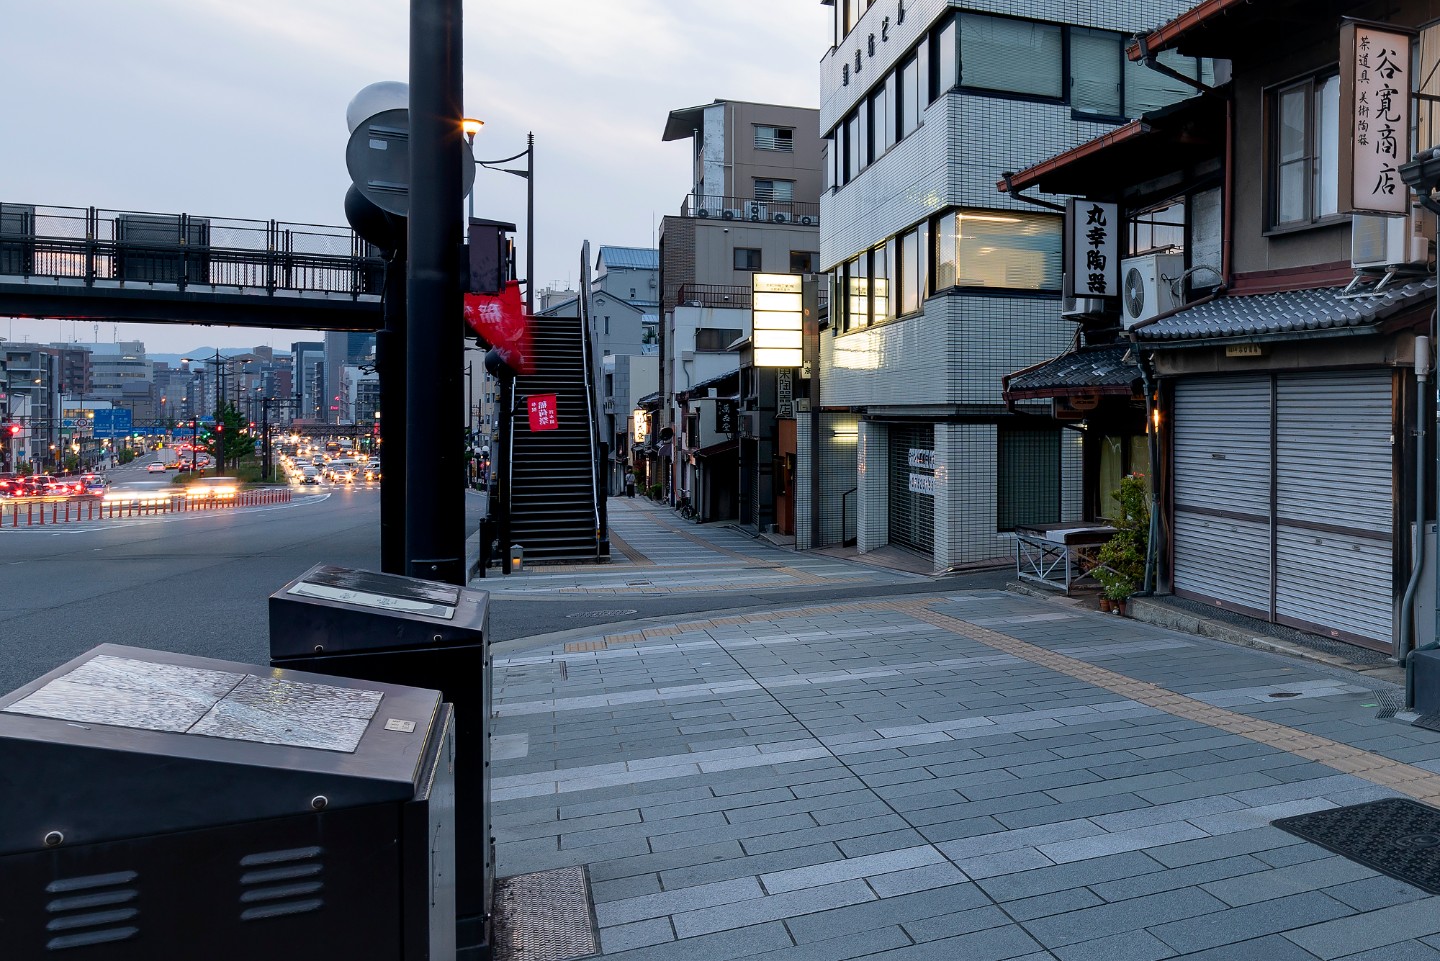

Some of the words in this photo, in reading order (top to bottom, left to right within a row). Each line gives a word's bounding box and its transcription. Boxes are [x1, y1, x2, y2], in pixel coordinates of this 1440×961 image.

[1357, 36, 1371, 85] 茶道具
[1357, 91, 1370, 146] 美術陶器
[1372, 48, 1403, 195] 谷寛商店
[1086, 203, 1107, 294] 丸幸陶器
